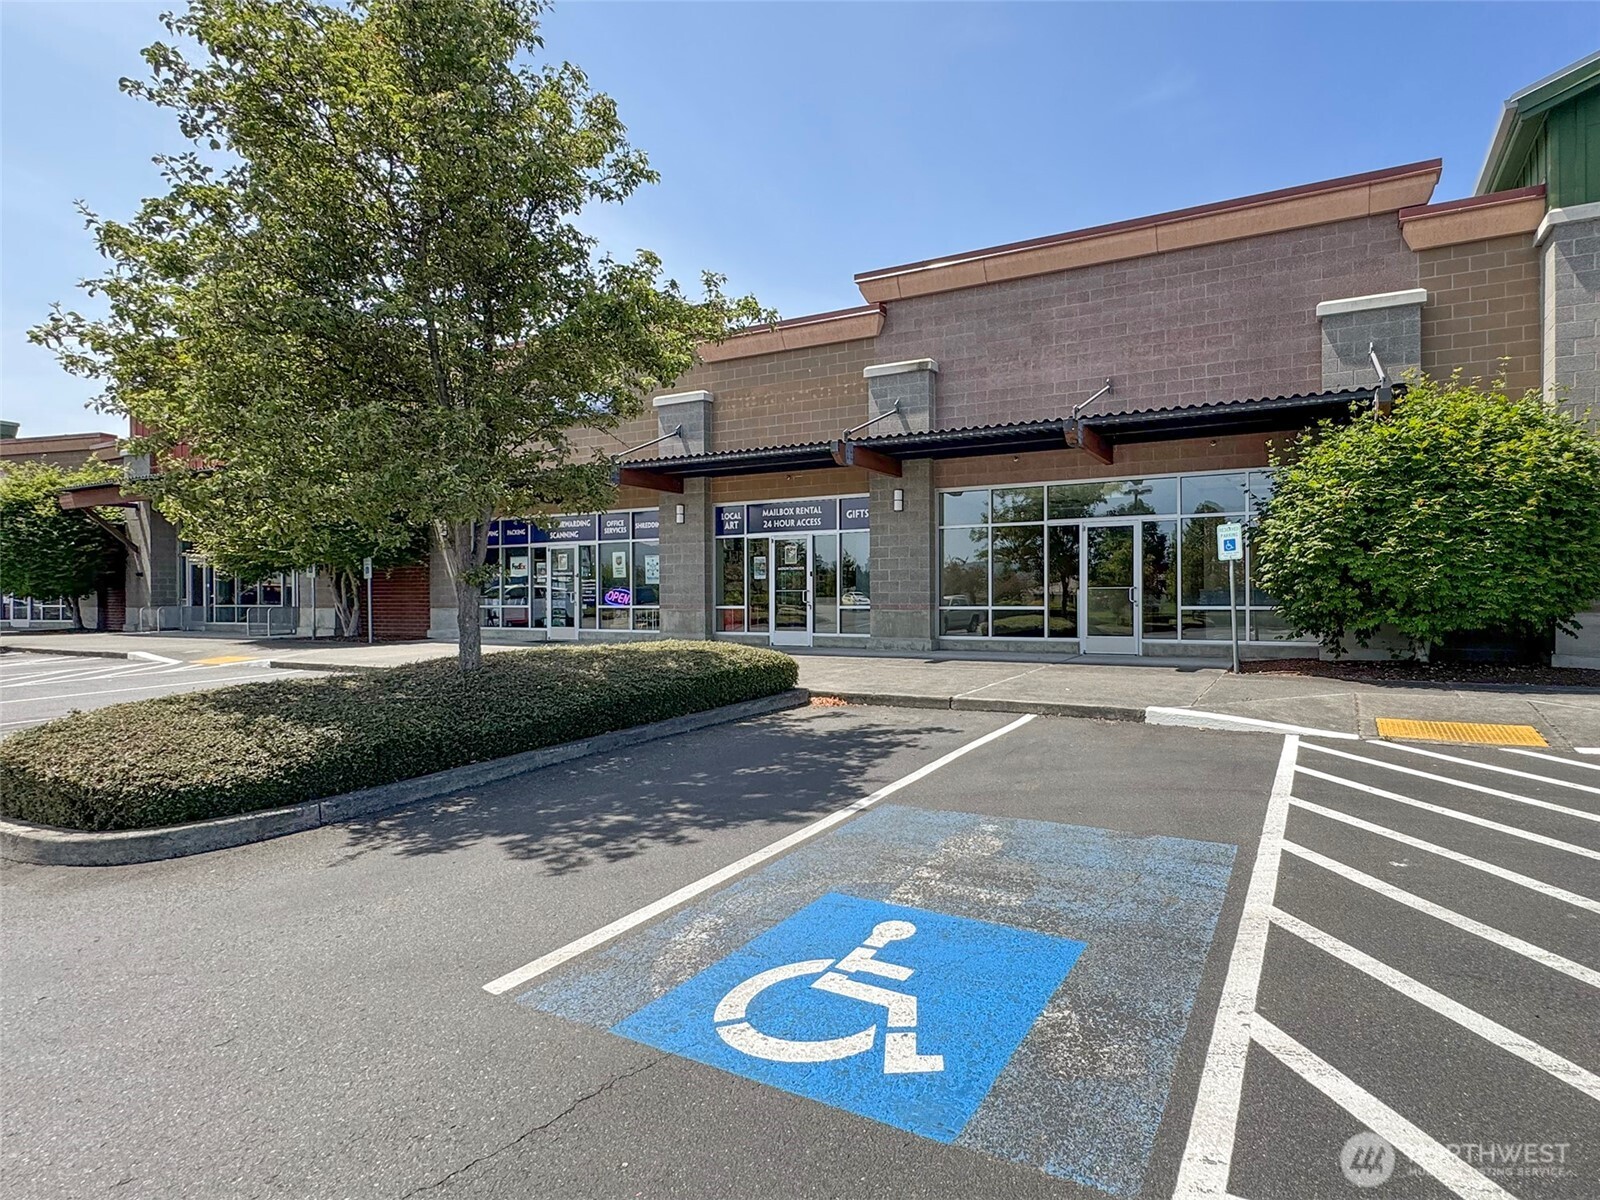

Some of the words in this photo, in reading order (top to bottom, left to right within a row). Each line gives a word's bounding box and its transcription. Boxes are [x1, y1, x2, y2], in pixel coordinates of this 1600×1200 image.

[762, 507, 794, 516] MAILBOX
[796, 506, 822, 515] RENTAL
[846, 508, 869, 519] GIFTS
[721, 512, 741, 520] LOCAL
[606, 519, 625, 527] OFFICE
[724, 521, 739, 530] ART
[763, 520, 772, 528] 24
[774, 519, 795, 527] HOUR
[797, 518, 821, 526] ACCESS
[506, 528, 526, 536] PACKING
[549, 530, 579, 539] SCANNING
[604, 526, 627, 535] SERVICES
[607, 590, 631, 605] OPEN
